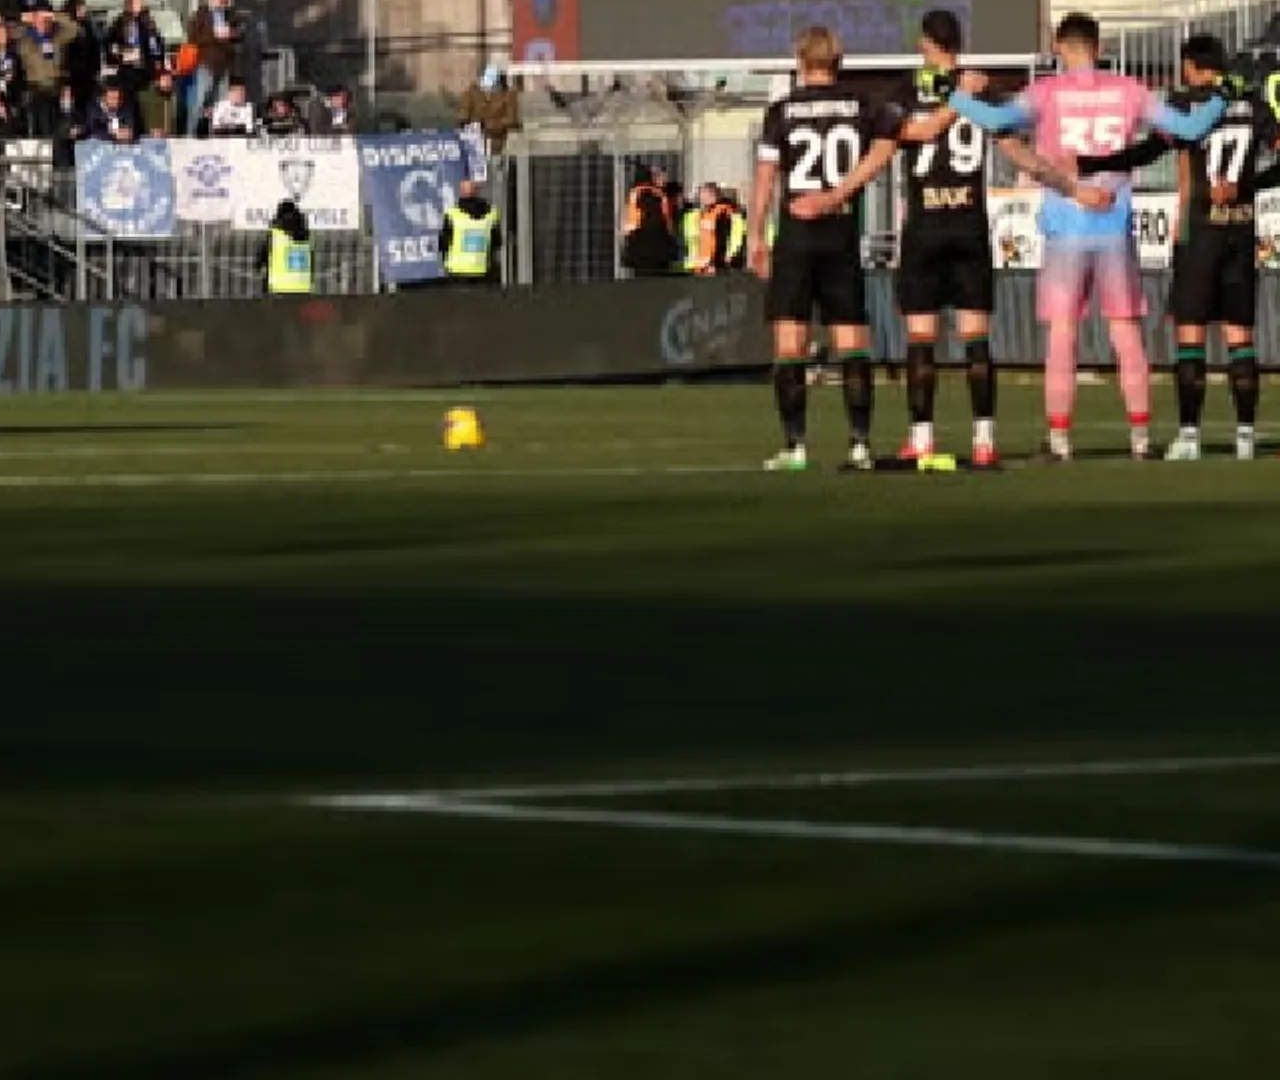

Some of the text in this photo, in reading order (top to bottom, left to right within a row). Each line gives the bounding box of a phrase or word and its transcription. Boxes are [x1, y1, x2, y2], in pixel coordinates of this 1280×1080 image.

[789, 125, 859, 189] 20
[1060, 116, 1126, 156] 35
[89, 307, 147, 394] FC
